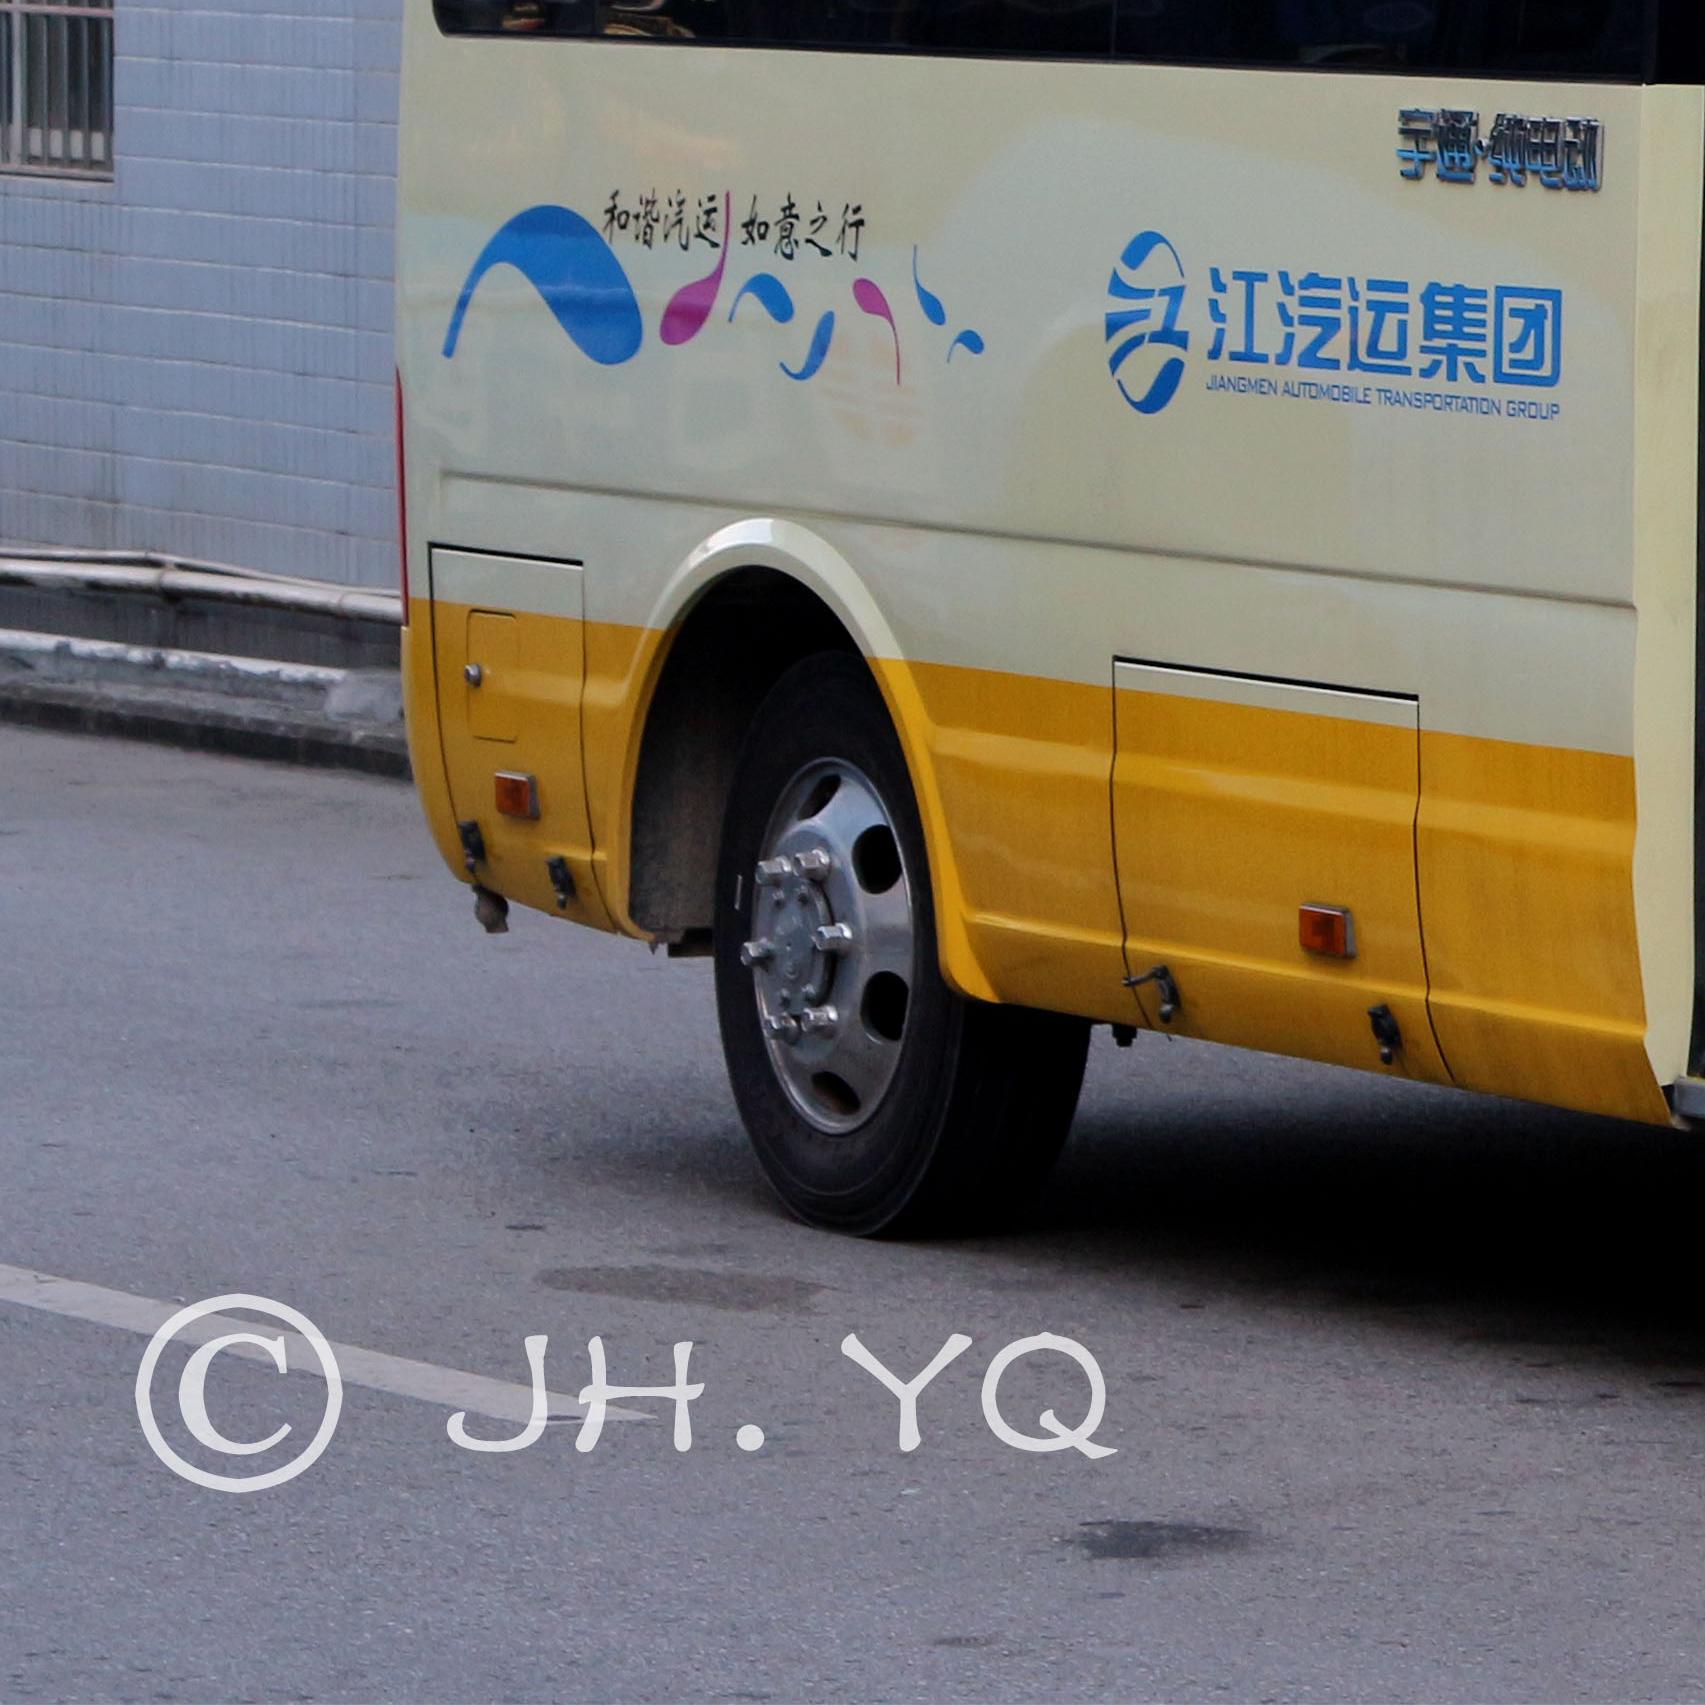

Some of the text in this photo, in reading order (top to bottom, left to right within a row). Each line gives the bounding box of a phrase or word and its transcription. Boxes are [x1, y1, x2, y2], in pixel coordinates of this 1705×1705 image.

[603, 188, 866, 262] 和谐汽运 如意之行
[1206, 266, 1563, 388] 江汽运集团
[1206, 373, 1561, 421] JIANGMEN AUTOMOBILE TRANSPORTATION GROUP
